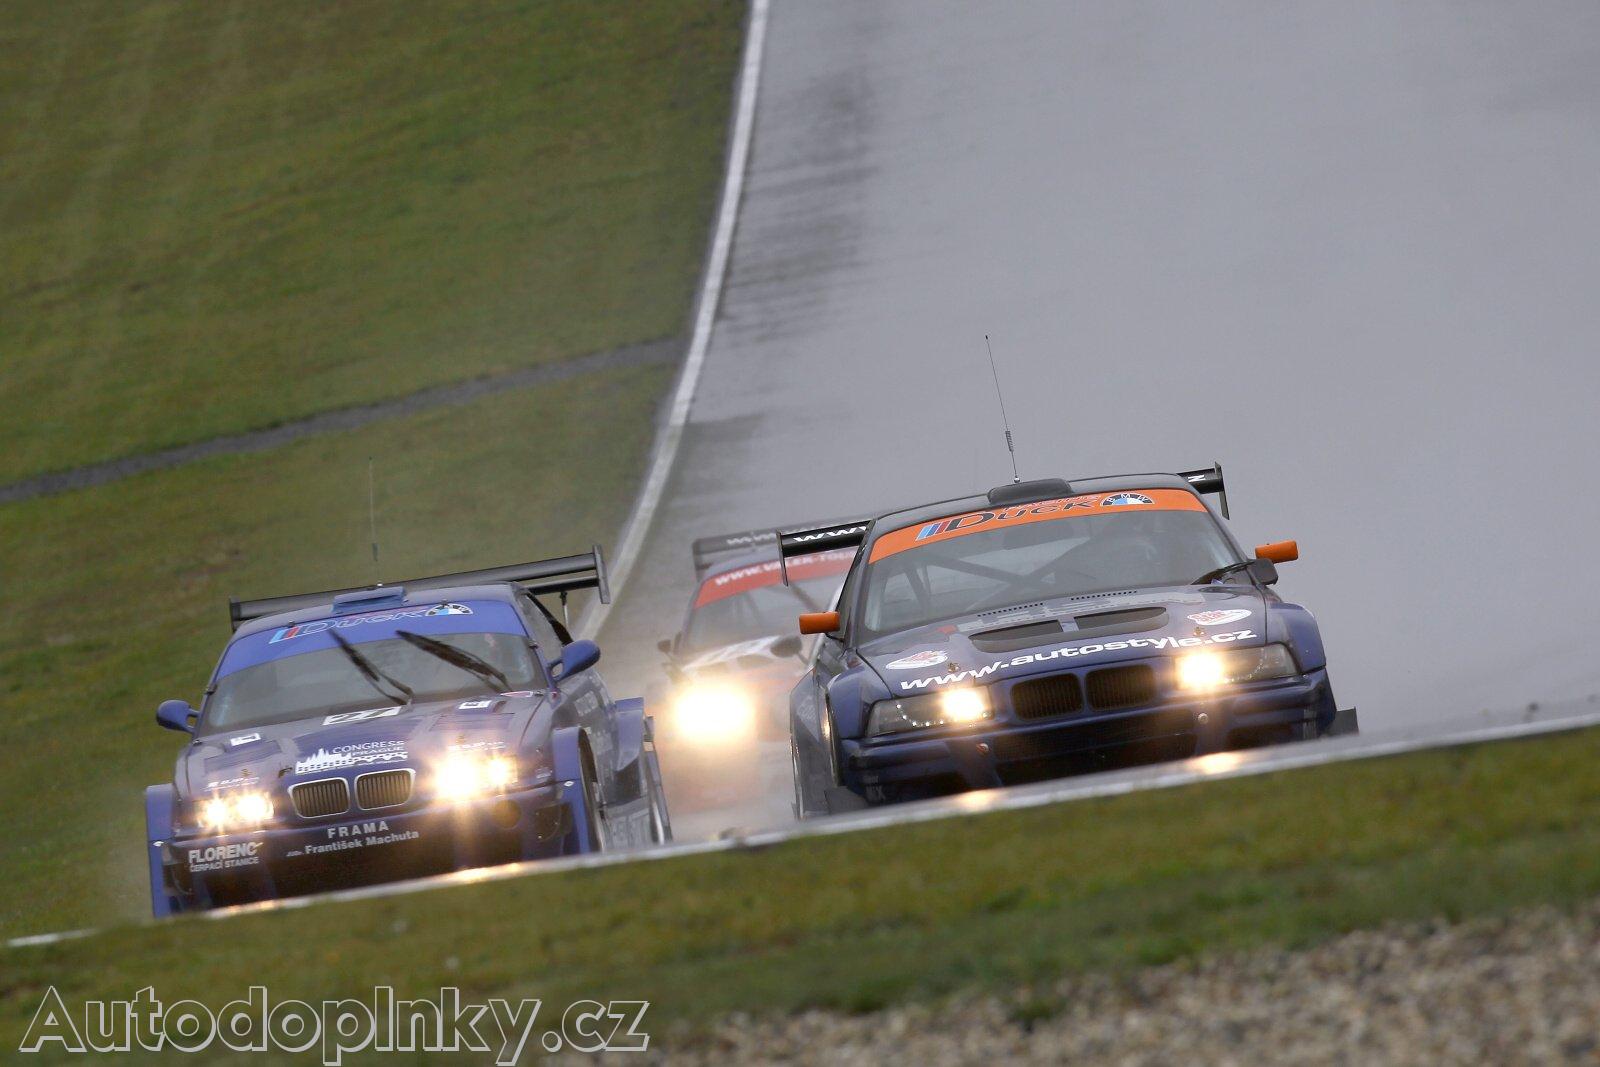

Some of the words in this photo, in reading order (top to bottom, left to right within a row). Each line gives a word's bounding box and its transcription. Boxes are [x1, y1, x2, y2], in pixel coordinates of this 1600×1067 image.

[900, 629, 1257, 690] www.autostyle.cz
[332, 740, 405, 754] CONGRESS
[327, 820, 389, 839] FRAMA
[188, 841, 260, 864] FLORENC
[305, 839, 362, 855] František
[366, 830, 420, 846] Machuta
